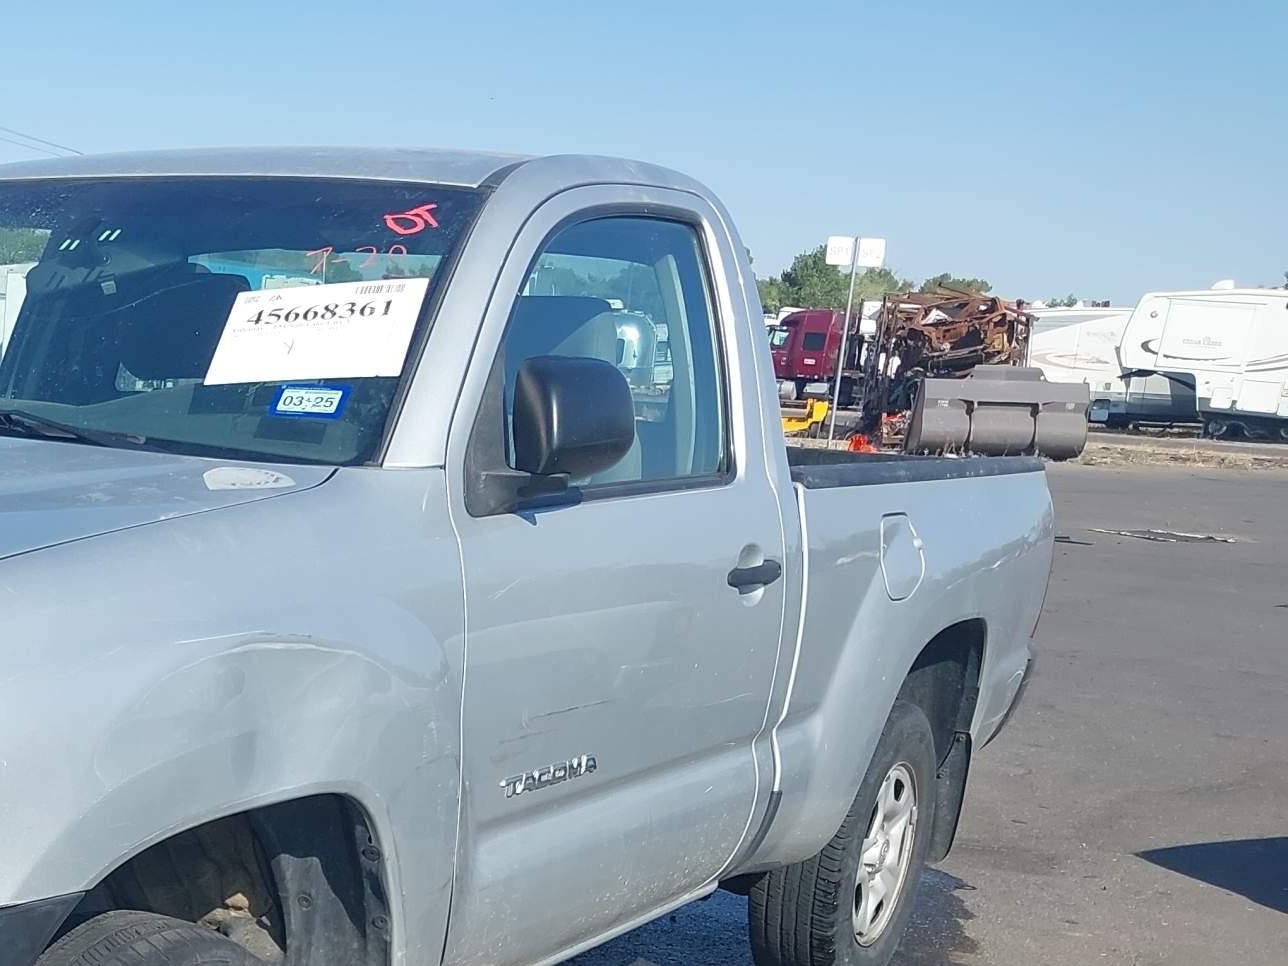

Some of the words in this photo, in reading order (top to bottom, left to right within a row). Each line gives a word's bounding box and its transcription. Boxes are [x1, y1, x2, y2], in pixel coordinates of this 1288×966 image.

[247, 299, 393, 325] 45668361
[283, 395, 304, 407] 03
[312, 396, 336, 408] 25
[499, 754, 597, 798] TACOMA
